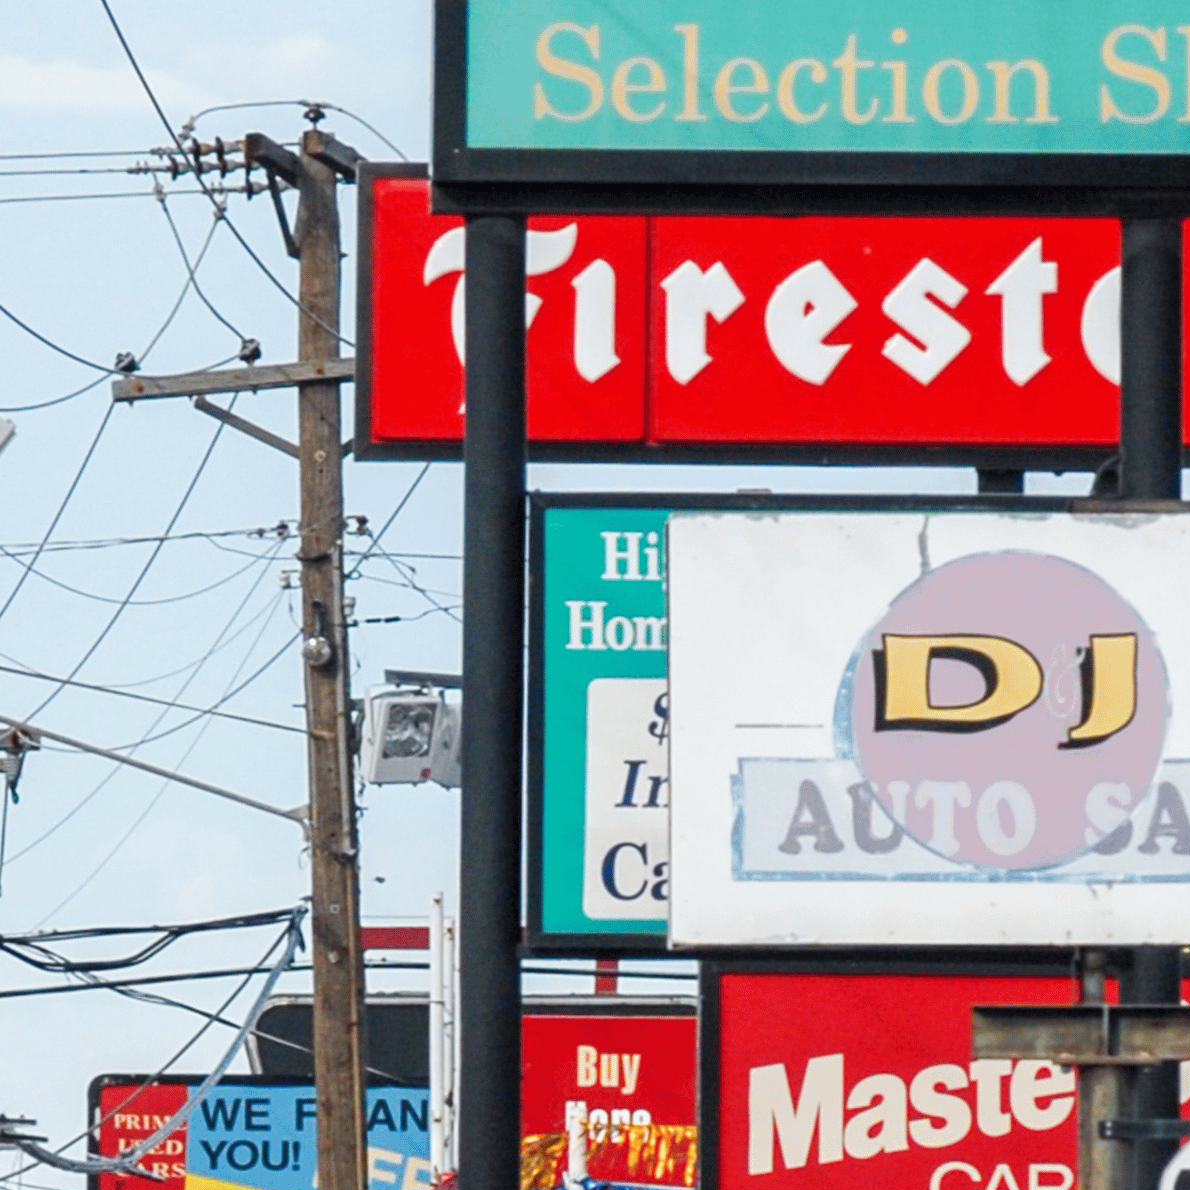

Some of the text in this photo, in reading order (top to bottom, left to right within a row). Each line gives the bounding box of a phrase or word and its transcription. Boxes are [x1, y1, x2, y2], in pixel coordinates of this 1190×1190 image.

[533, 22, 1060, 125] Selection
[777, 778, 1037, 856] AUTO
[576, 1045, 641, 1095] Buy
[201, 1097, 271, 1132] WE
[201, 1139, 301, 1171] YOU!
